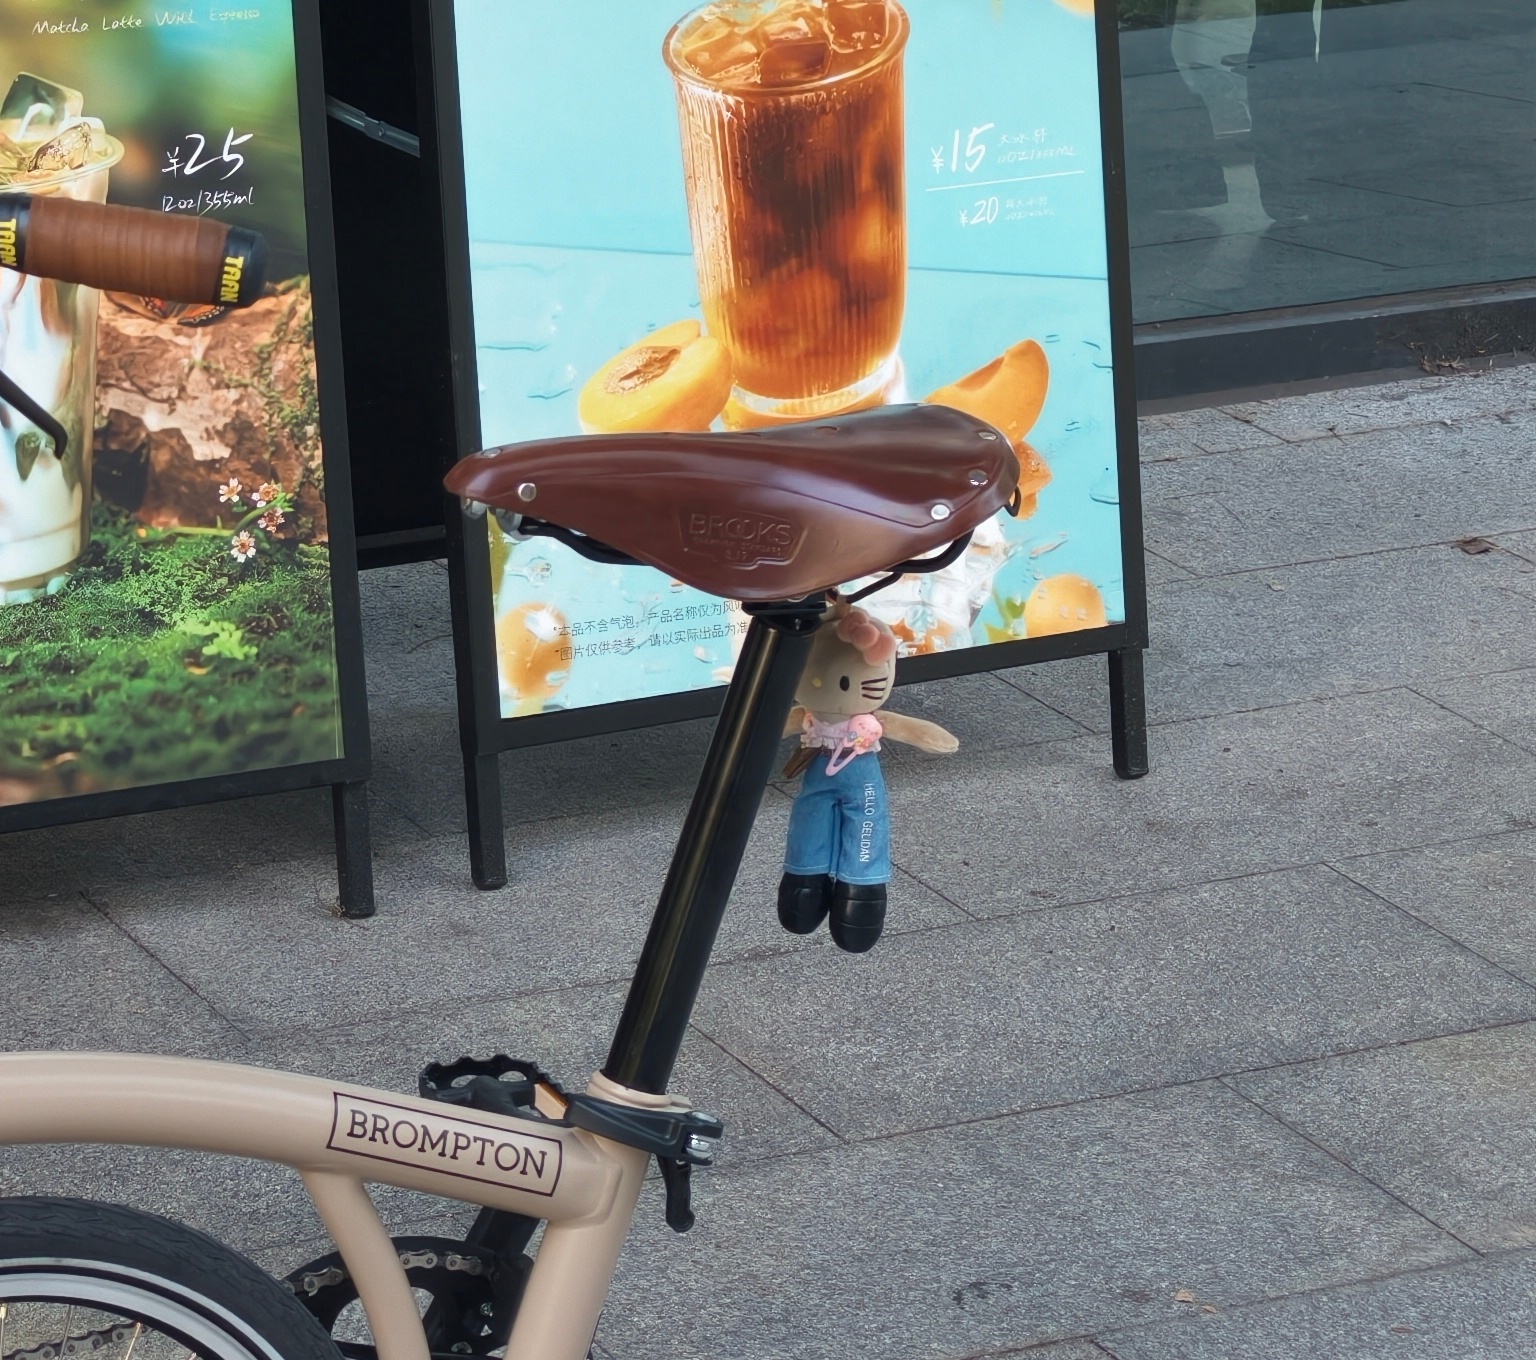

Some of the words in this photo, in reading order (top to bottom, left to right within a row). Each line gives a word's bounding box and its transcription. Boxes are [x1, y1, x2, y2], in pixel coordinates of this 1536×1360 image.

[31, 19, 90, 36] Matcha
[101, 16, 145, 31] Latte
[161, 126, 254, 181] ¥25
[930, 122, 996, 174] ¥15
[959, 196, 999, 228] ¥20
[689, 512, 793, 546] BROOKS
[864, 783, 877, 816] HELLO
[346, 1109, 548, 1179] BROMPTON
